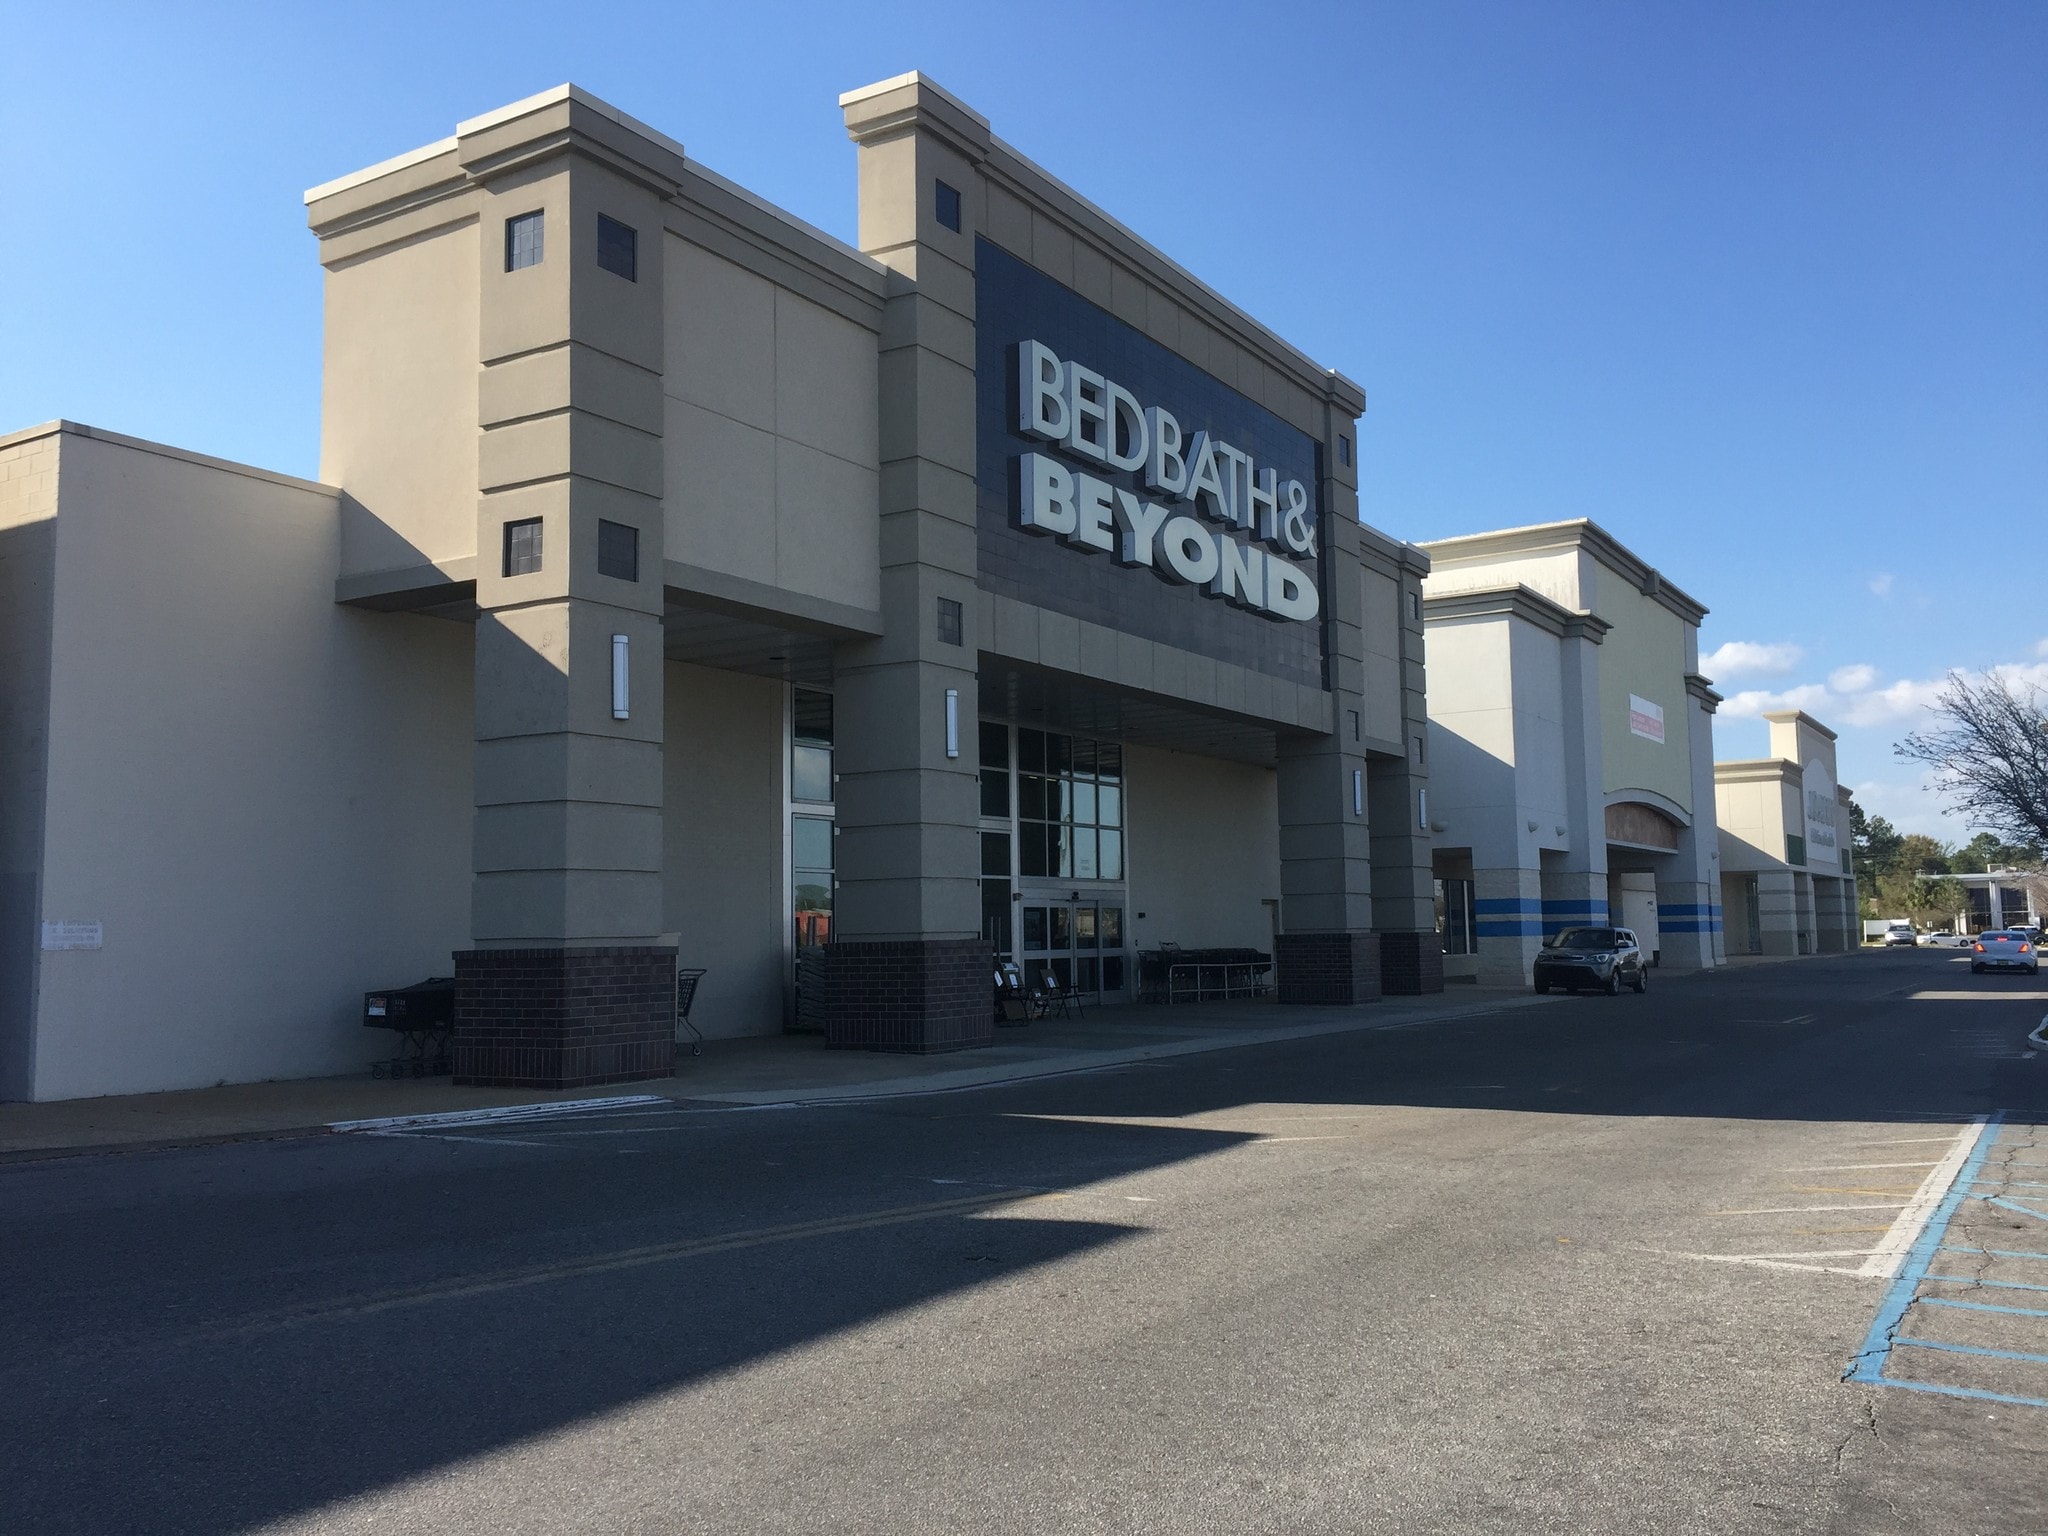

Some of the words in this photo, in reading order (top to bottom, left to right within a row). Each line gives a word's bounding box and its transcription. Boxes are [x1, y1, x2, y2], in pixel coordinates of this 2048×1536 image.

[1019, 339, 1149, 472] BED
[1145, 406, 1277, 541] BATH
[1277, 479, 1317, 559] &
[1020, 452, 1319, 622] BEYOND
